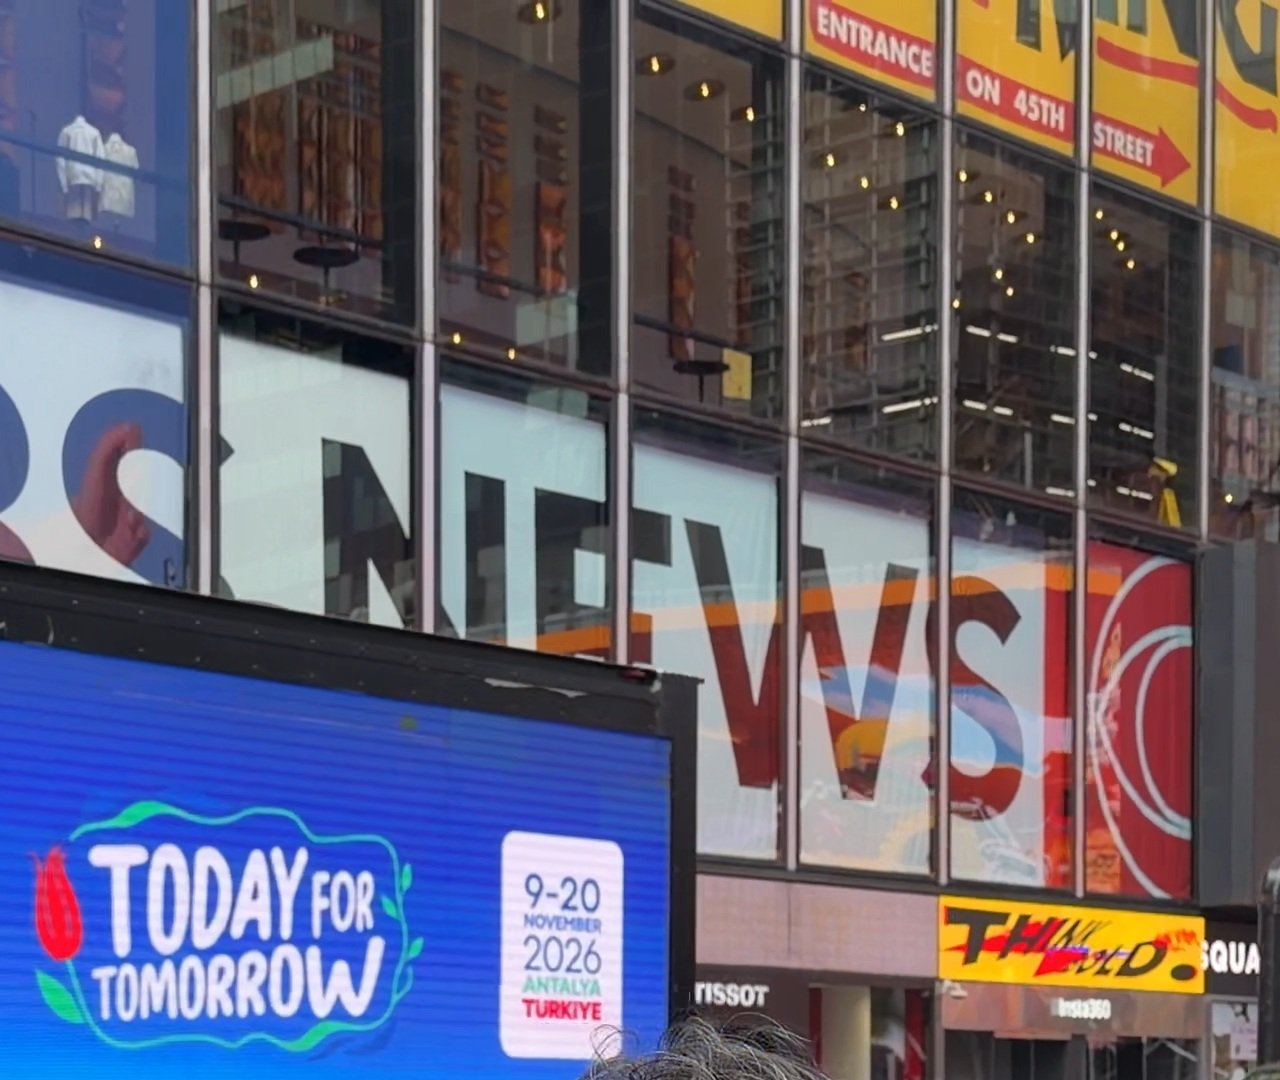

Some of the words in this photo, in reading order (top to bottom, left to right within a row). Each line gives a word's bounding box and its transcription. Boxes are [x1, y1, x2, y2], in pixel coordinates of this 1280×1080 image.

[816, 7, 933, 79] ENTRANCE
[965, 68, 1001, 106] ON
[1014, 88, 1066, 132] 45TH
[1093, 121, 1155, 167] STREET
[321, 437, 1023, 823] NEWS
[88, 843, 309, 958] TODAY
[311, 870, 375, 940] FOR
[524, 872, 601, 914] 9-20
[523, 914, 602, 934] NOVEMBER
[523, 934, 603, 975] 2026
[90, 935, 386, 1022] TOMORROW
[521, 975, 602, 998] ANTALYA
[694, 981, 770, 1007] TISSOT
